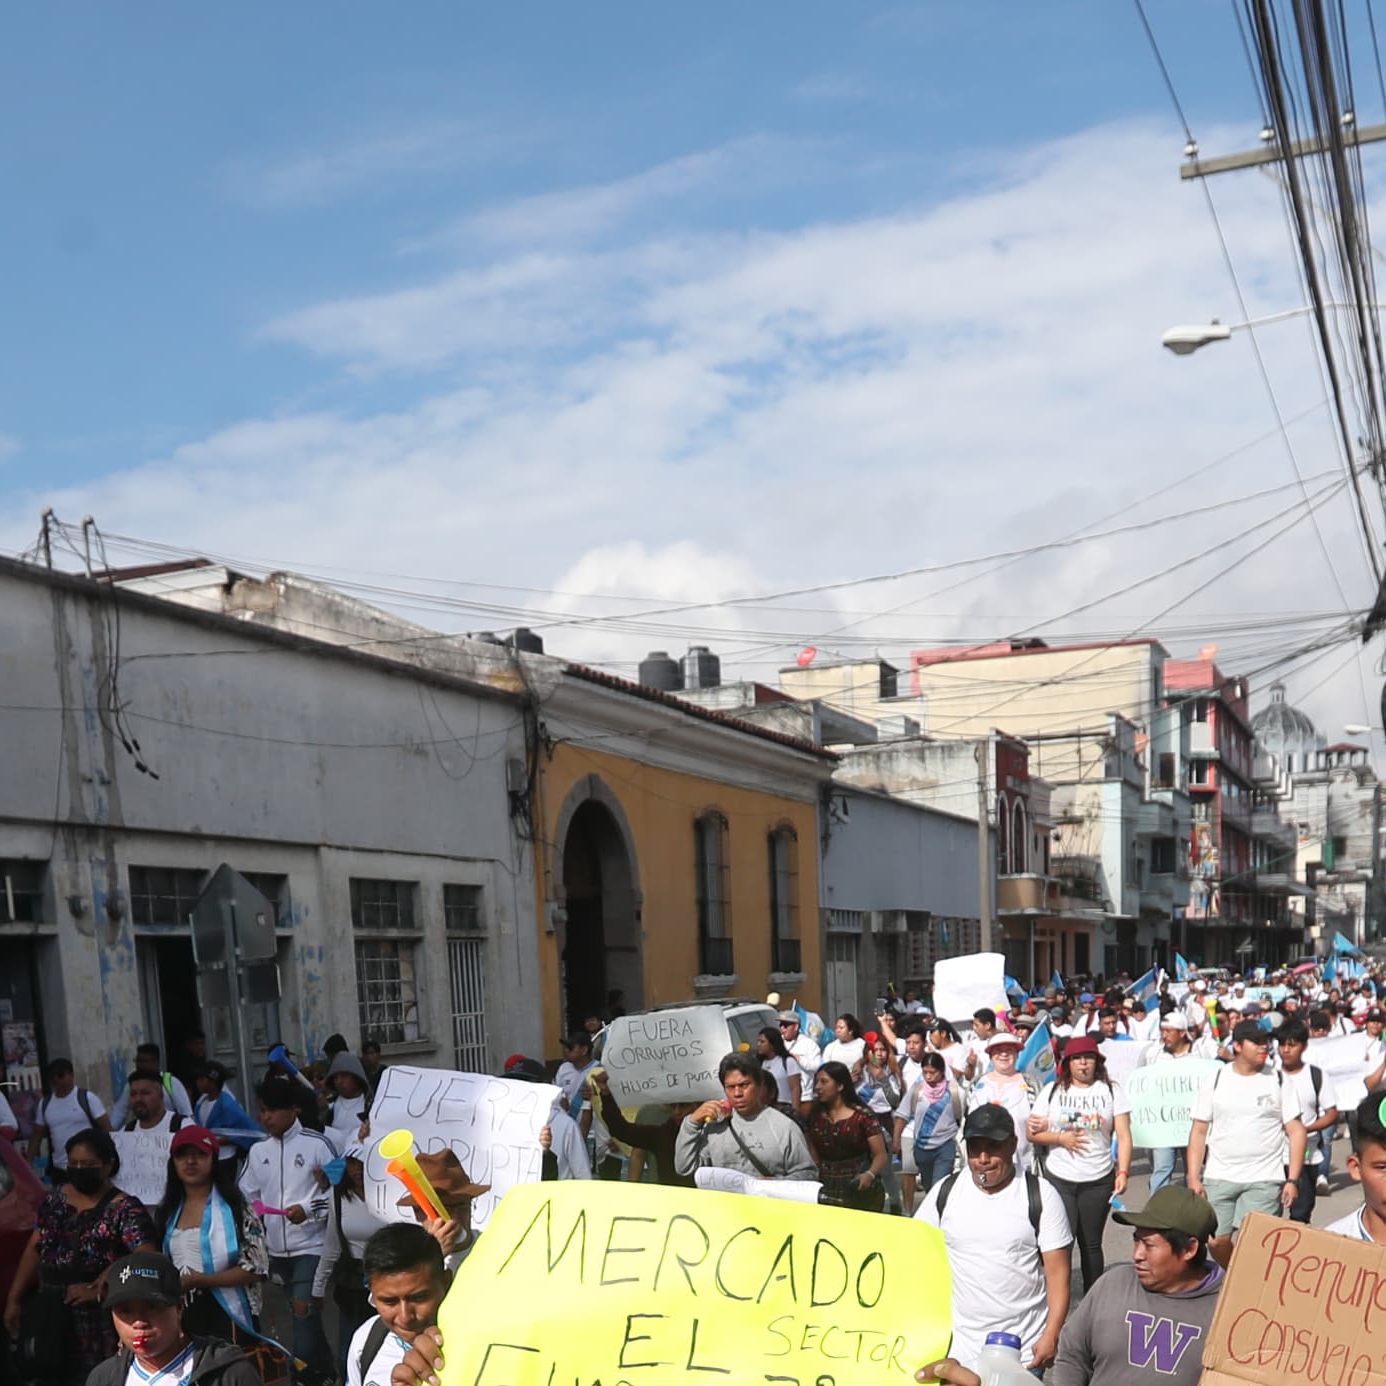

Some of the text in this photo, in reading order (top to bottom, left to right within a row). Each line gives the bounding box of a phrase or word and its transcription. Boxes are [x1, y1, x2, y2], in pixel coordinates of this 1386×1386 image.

[607, 1040, 704, 1070] CORRUPTOS
[628, 1017, 693, 1046] FUERA
[375, 1067, 535, 1134] FUERA
[497, 1199, 886, 1308] MERCADO
[618, 1312, 906, 1375] EL SECTOR
[1125, 1310, 1202, 1375] W
